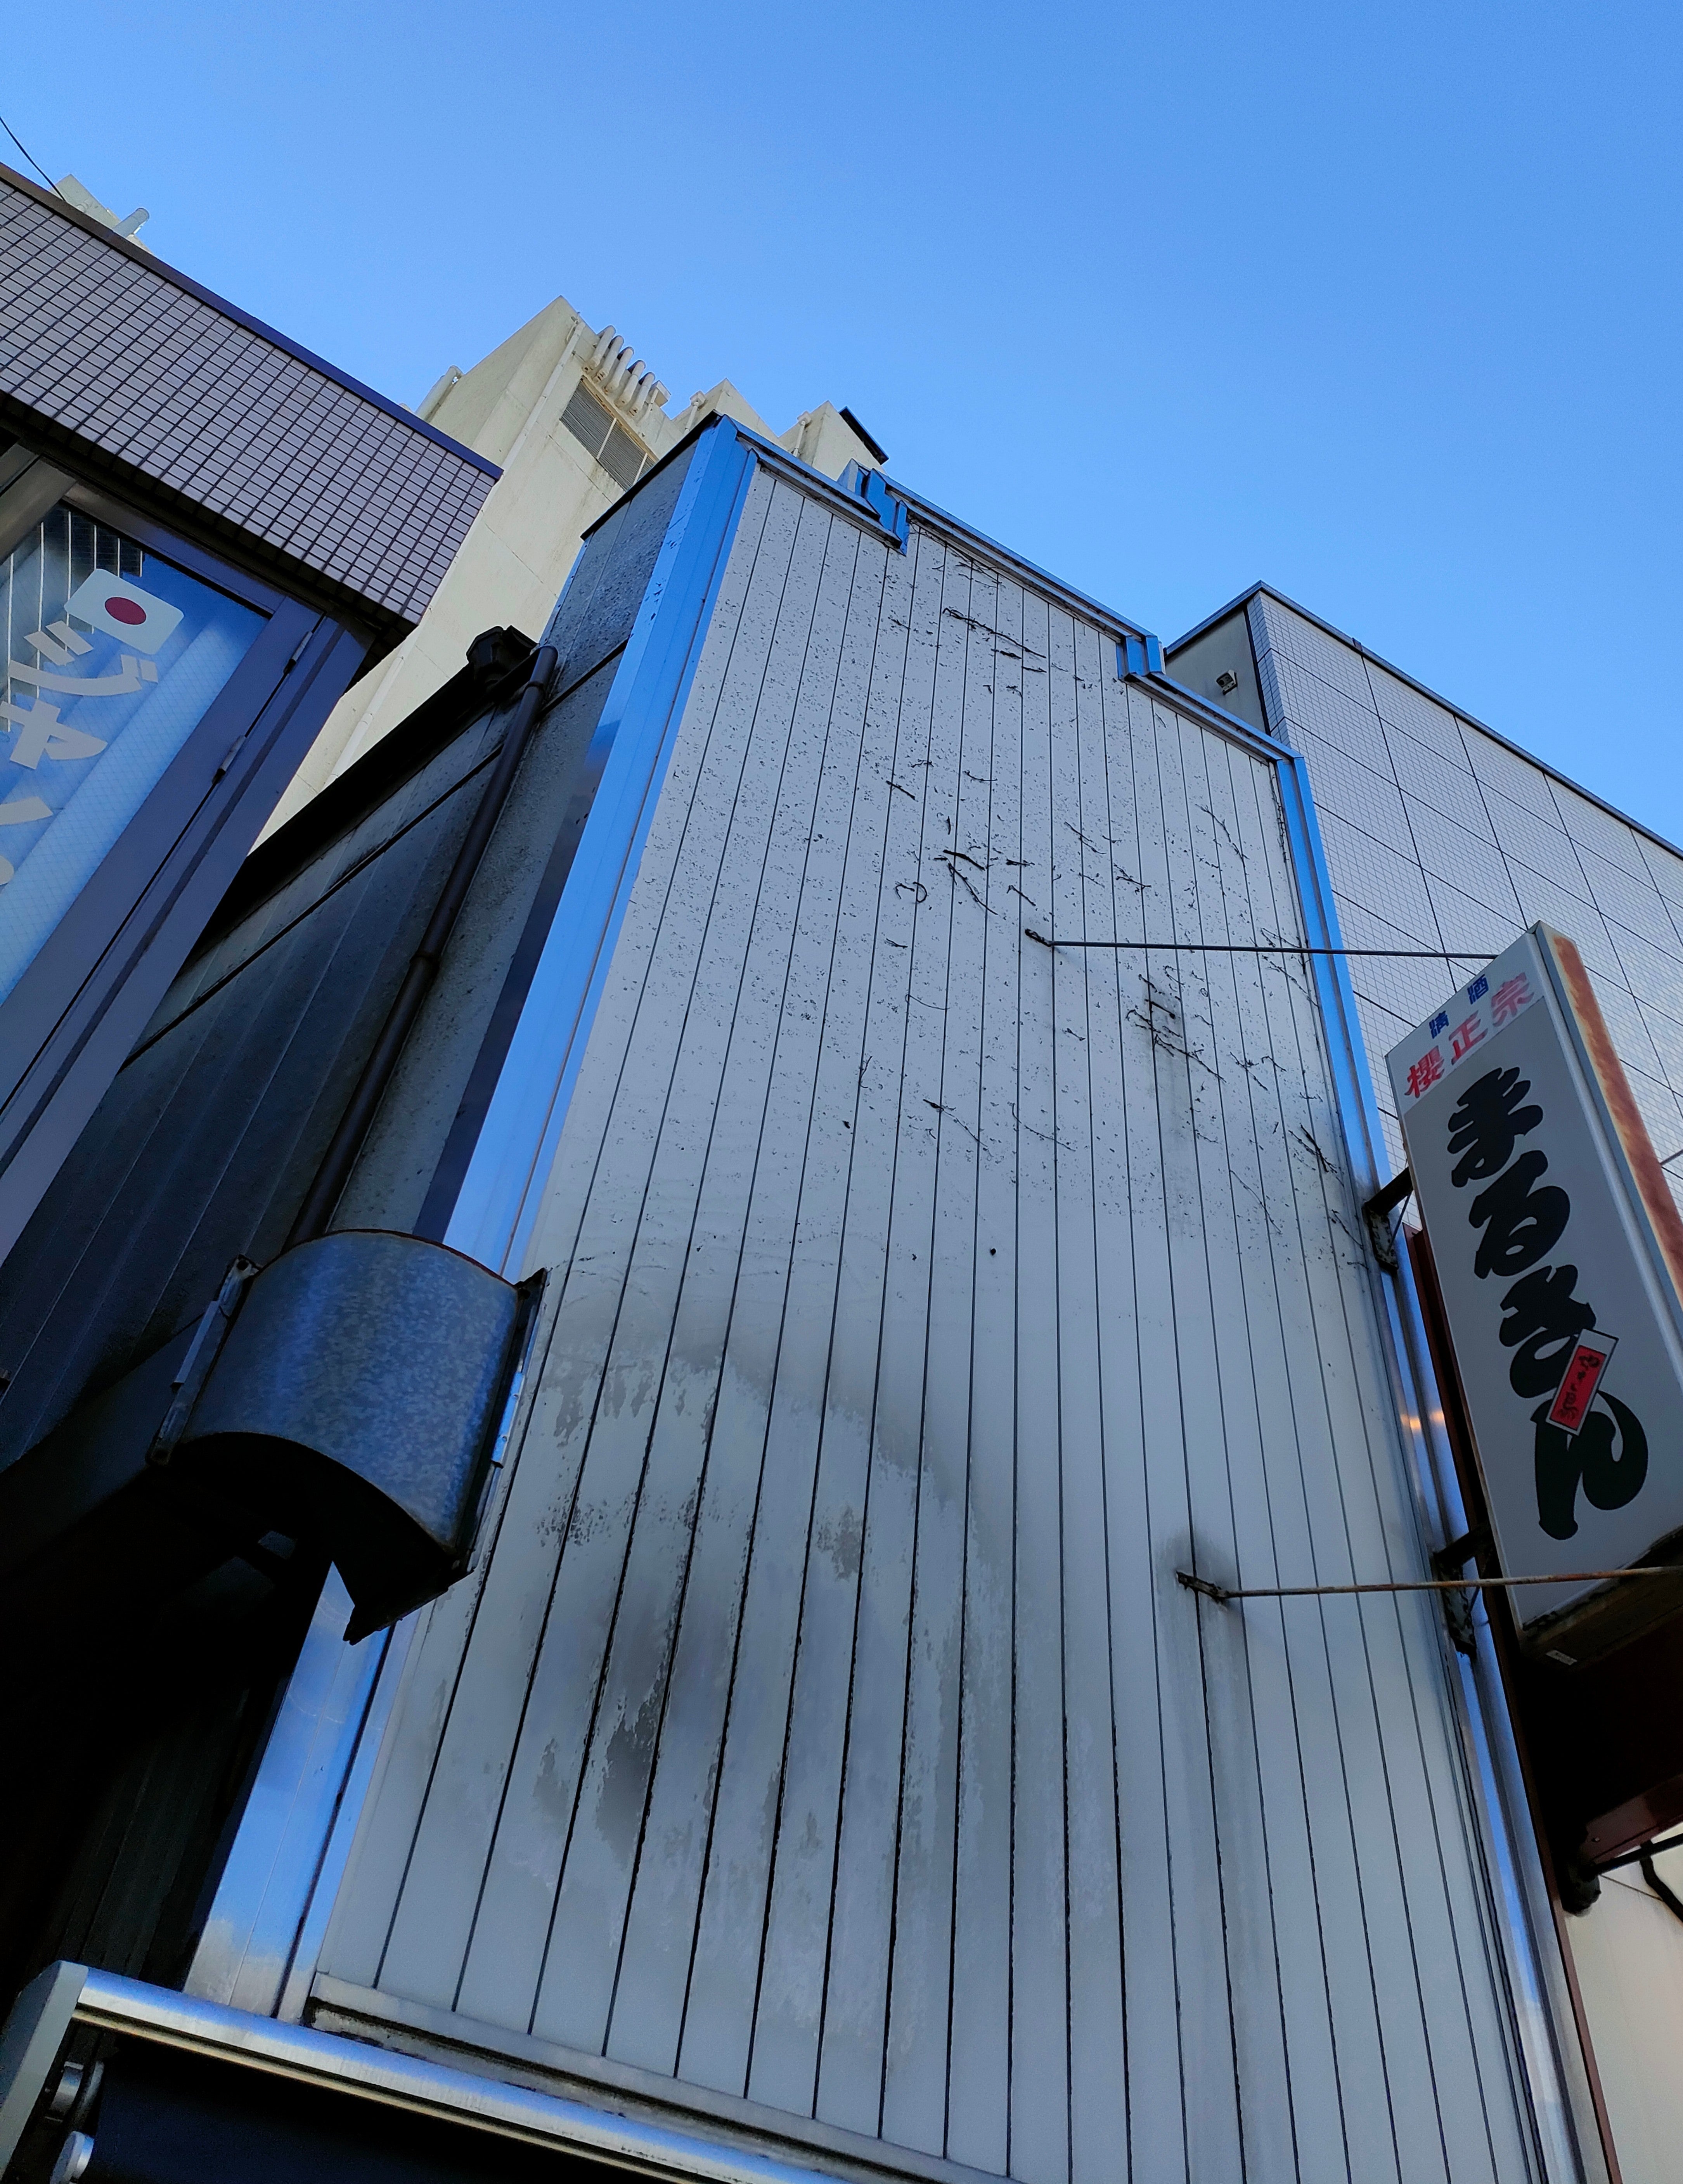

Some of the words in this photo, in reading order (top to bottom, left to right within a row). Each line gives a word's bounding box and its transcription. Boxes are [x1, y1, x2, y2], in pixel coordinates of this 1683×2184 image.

[0, 620, 158, 885] ジャ
[1404, 973, 1534, 1098] 櫻正宗
[1429, 974, 1489, 1038] 清酒
